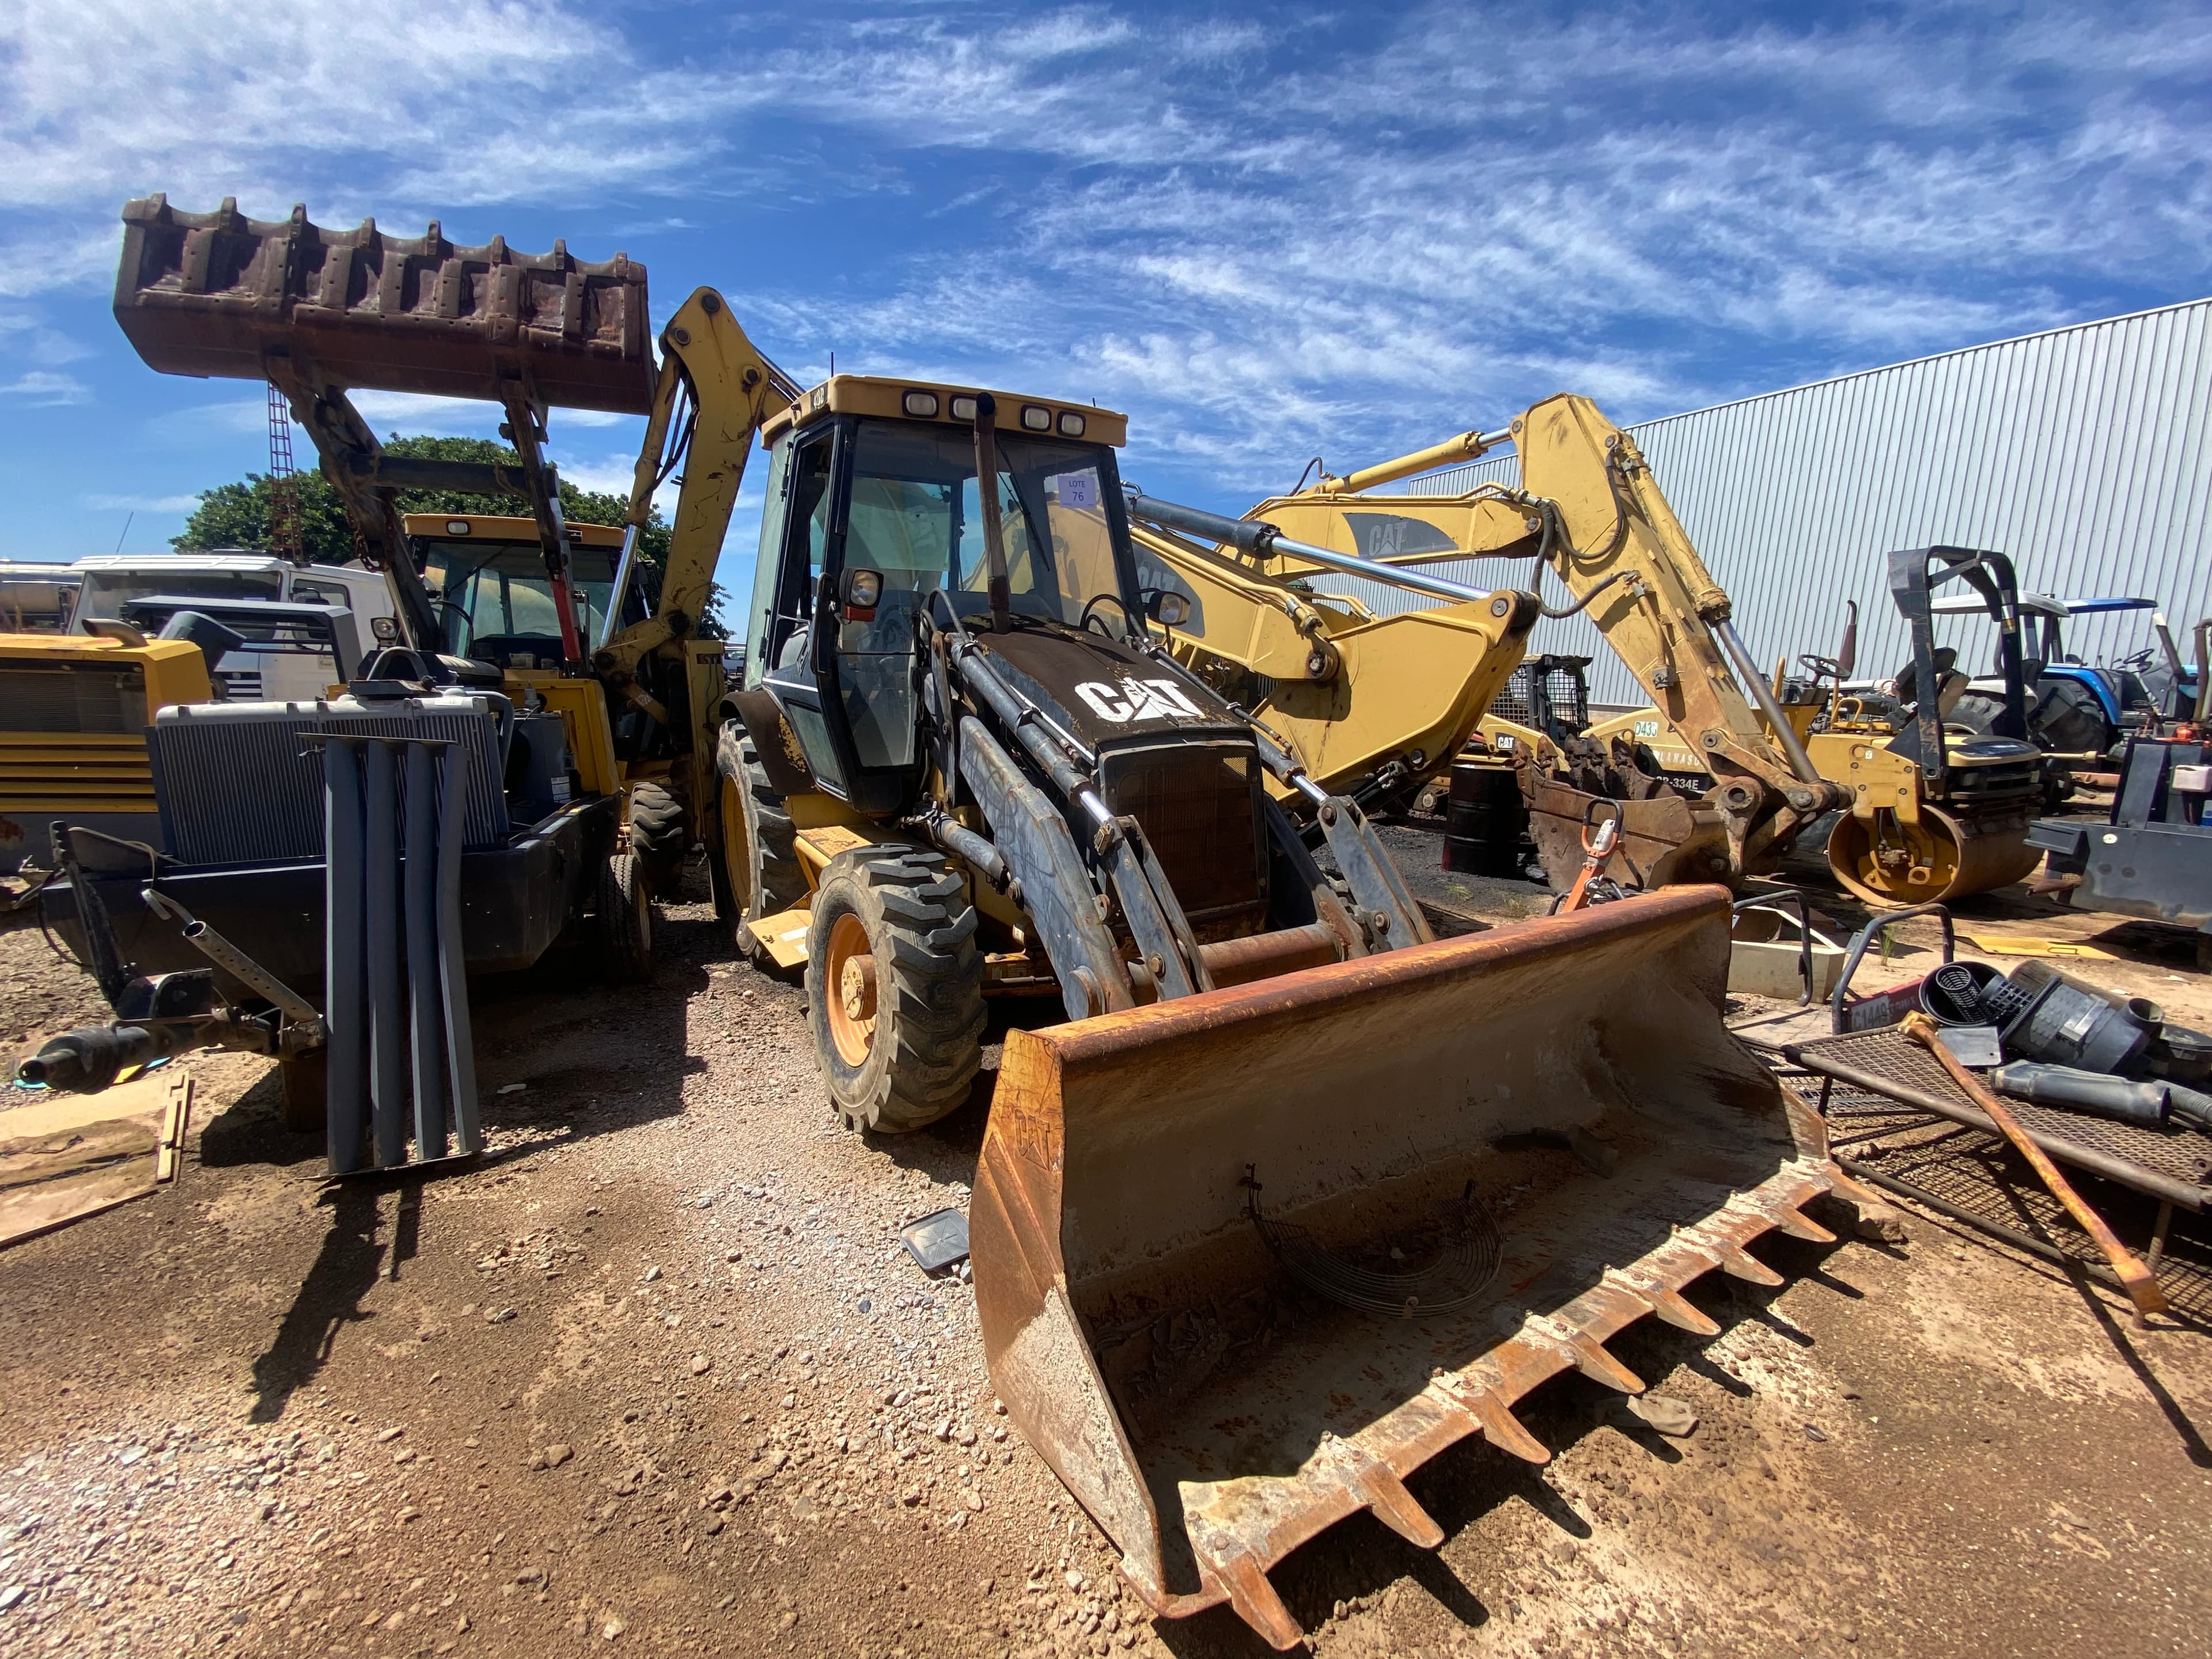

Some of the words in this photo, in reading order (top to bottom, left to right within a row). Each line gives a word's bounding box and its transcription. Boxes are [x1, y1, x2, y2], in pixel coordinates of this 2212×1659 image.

[1072, 491, 1084, 501] 76
[1368, 522, 1407, 556] CAT
[1074, 677, 1206, 722] CAT
[1498, 736, 1514, 749] CAT
[1014, 1109, 1051, 1171] CAT
